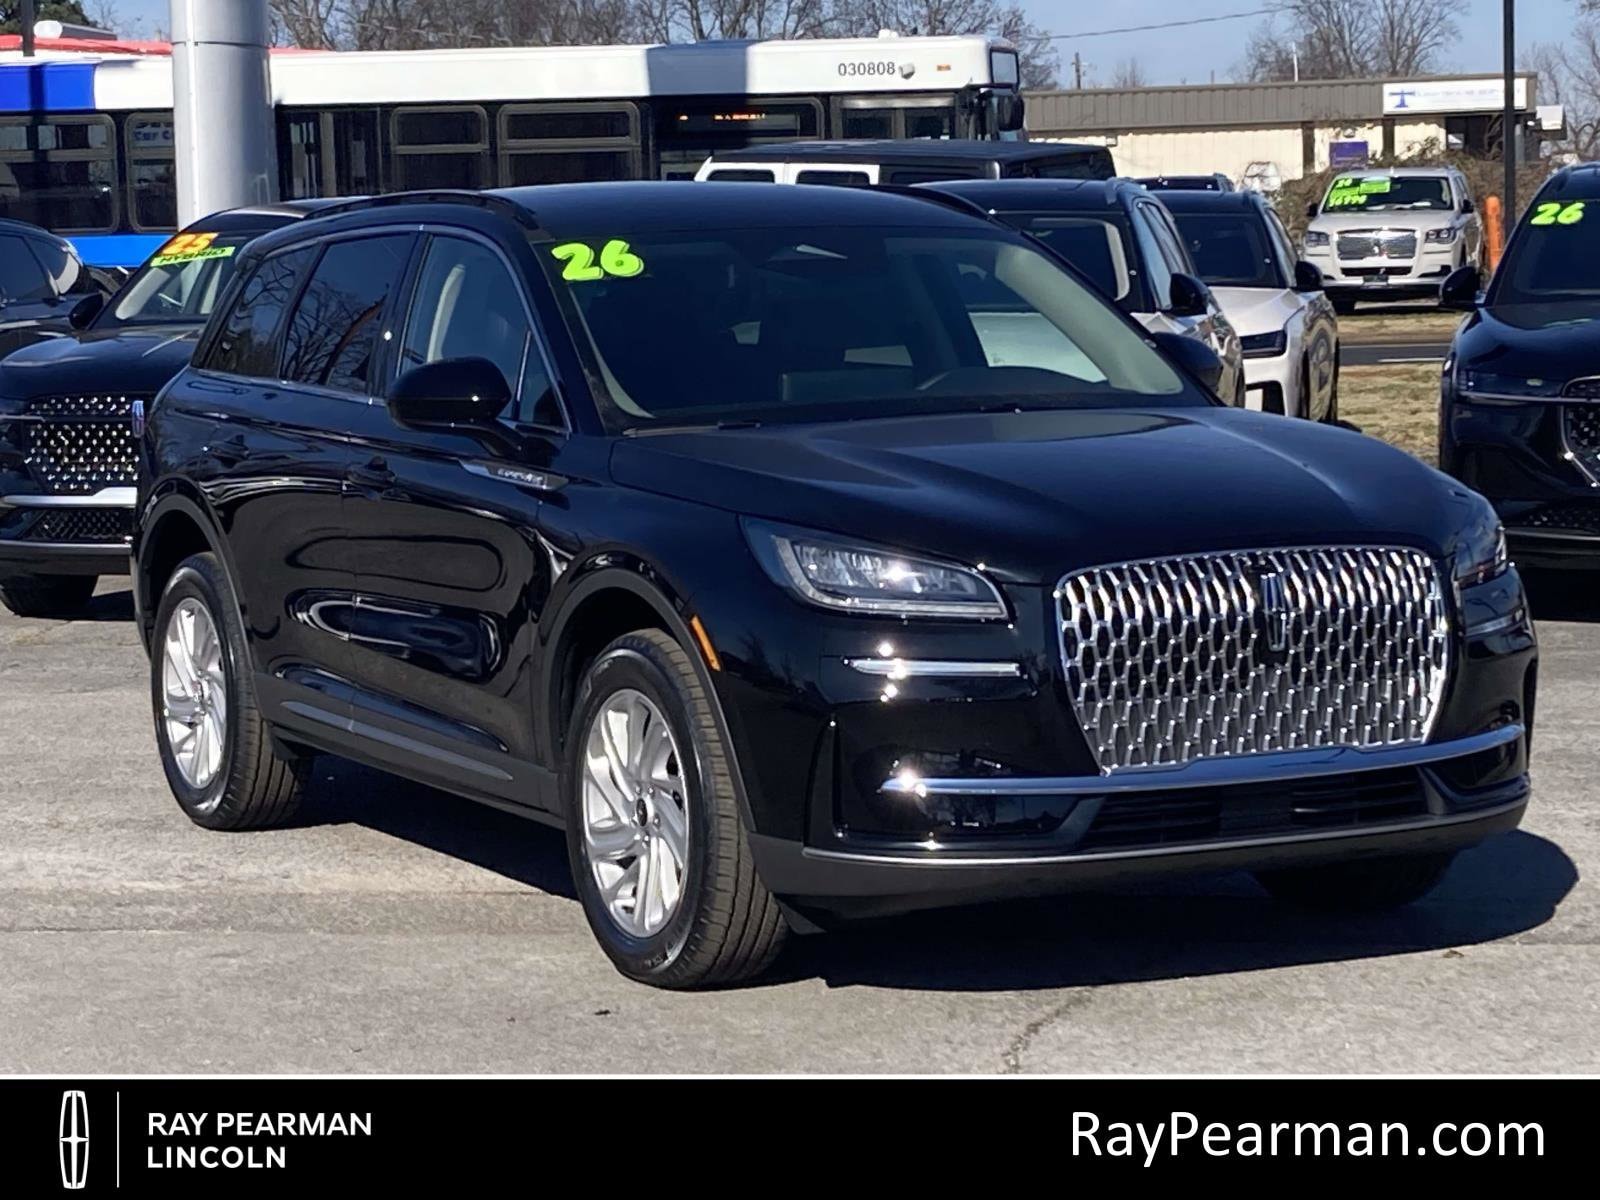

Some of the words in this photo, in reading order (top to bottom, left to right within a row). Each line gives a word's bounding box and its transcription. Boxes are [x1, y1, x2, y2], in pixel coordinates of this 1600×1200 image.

[837, 62, 897, 76] 030808
[1531, 202, 1586, 225] 26
[162, 232, 219, 255] 25
[551, 239, 645, 281] 26
